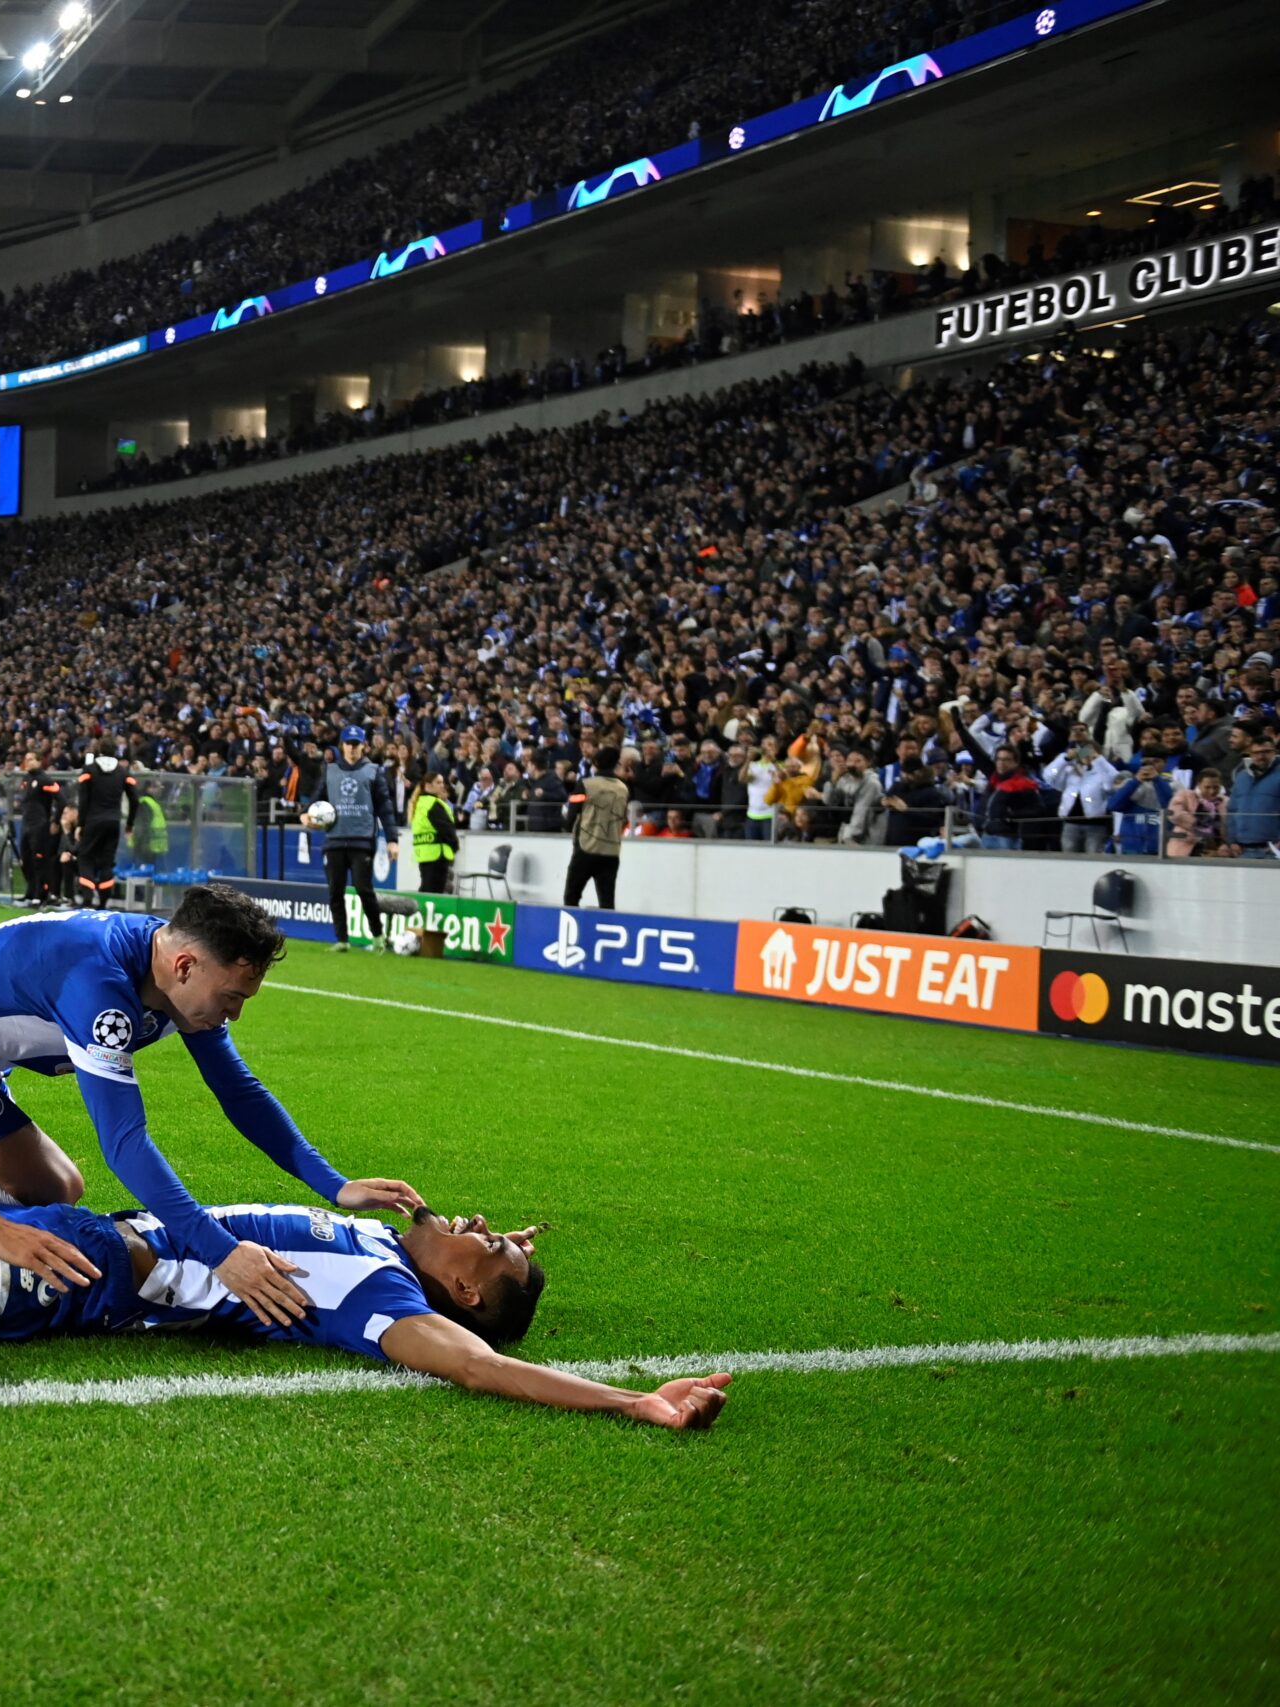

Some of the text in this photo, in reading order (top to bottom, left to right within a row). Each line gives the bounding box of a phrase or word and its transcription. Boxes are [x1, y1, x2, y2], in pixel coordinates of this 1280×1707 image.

[934, 227, 1280, 347] FUTEBOL CLUBE
[593, 923, 696, 973] PS5
[805, 938, 1010, 1010] JUST EAT
[1123, 983, 1280, 1039] maste
